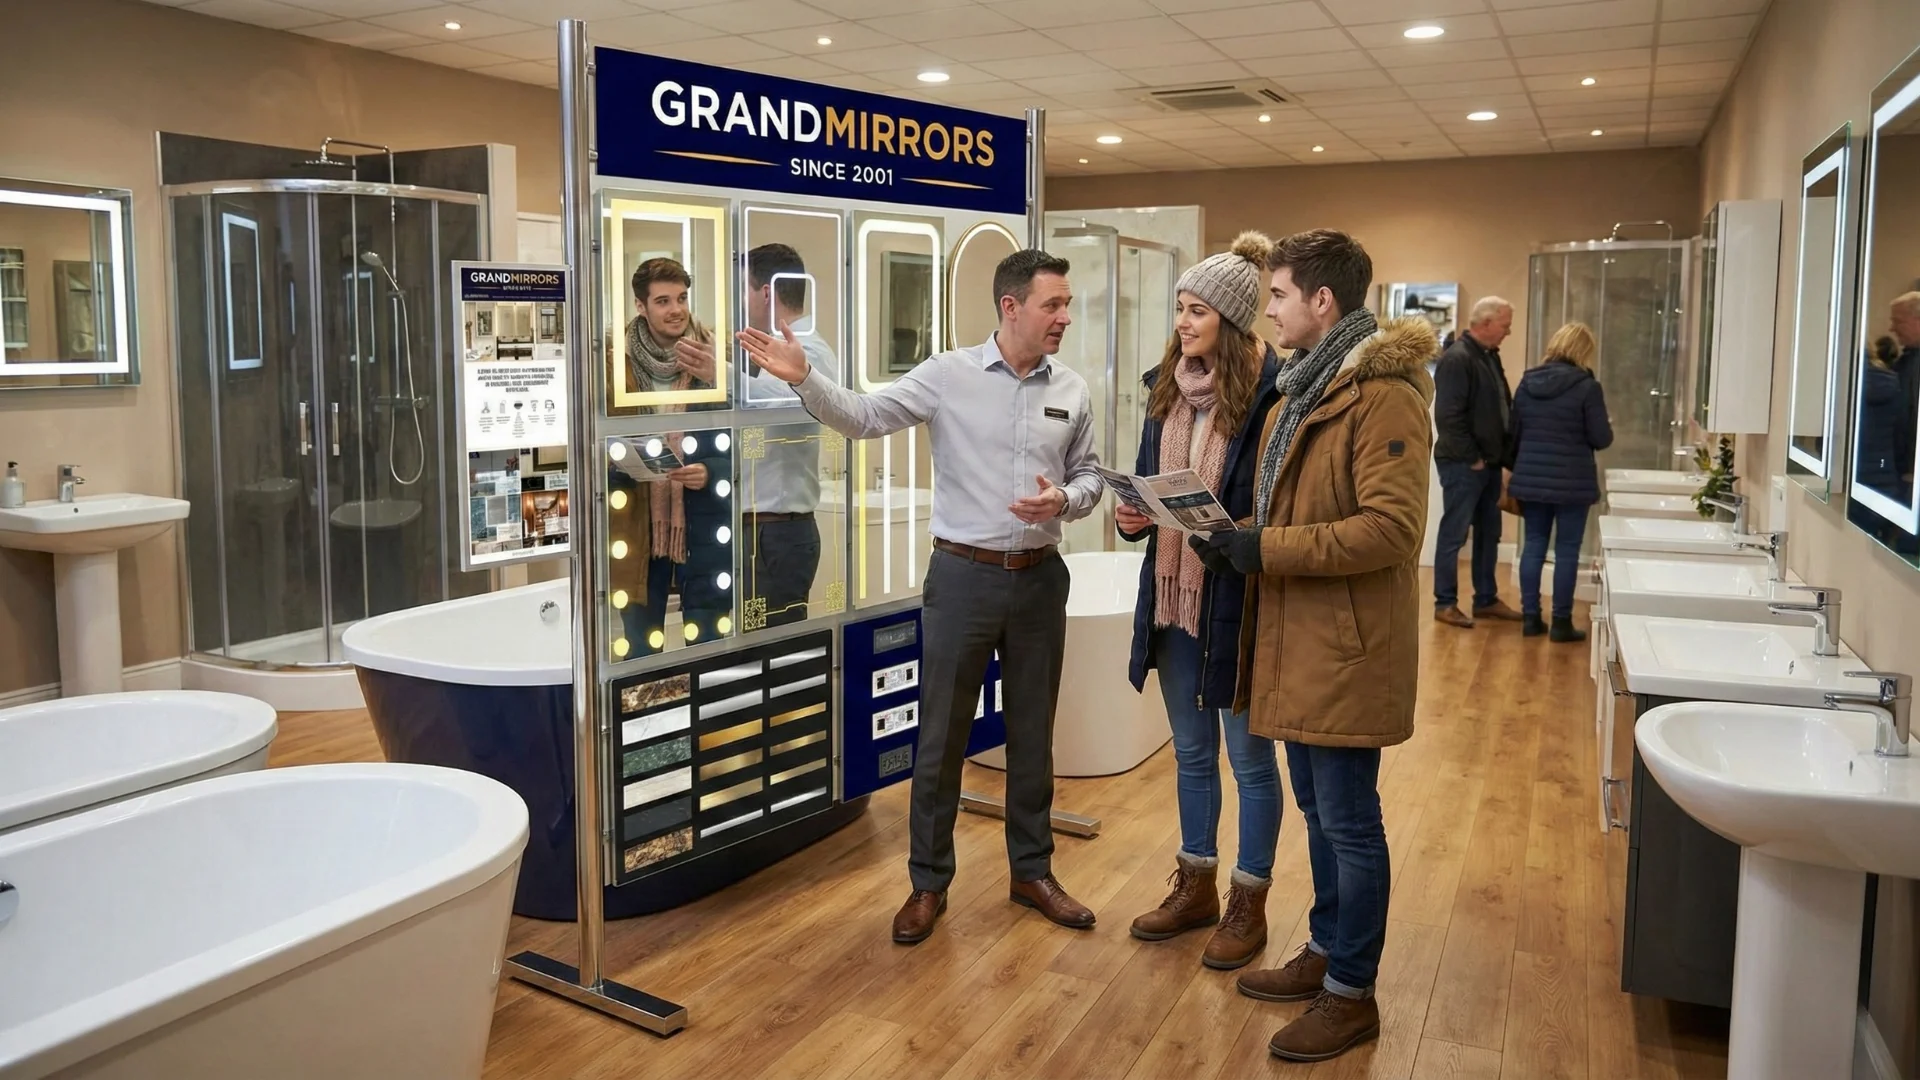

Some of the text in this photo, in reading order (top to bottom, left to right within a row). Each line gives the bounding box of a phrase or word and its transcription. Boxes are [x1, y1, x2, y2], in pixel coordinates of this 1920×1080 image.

[652, 81, 994, 167] GRANDMIRRORS
[790, 158, 893, 186] SINCE 2001
[470, 272, 559, 284] GRANDMIRRORS
